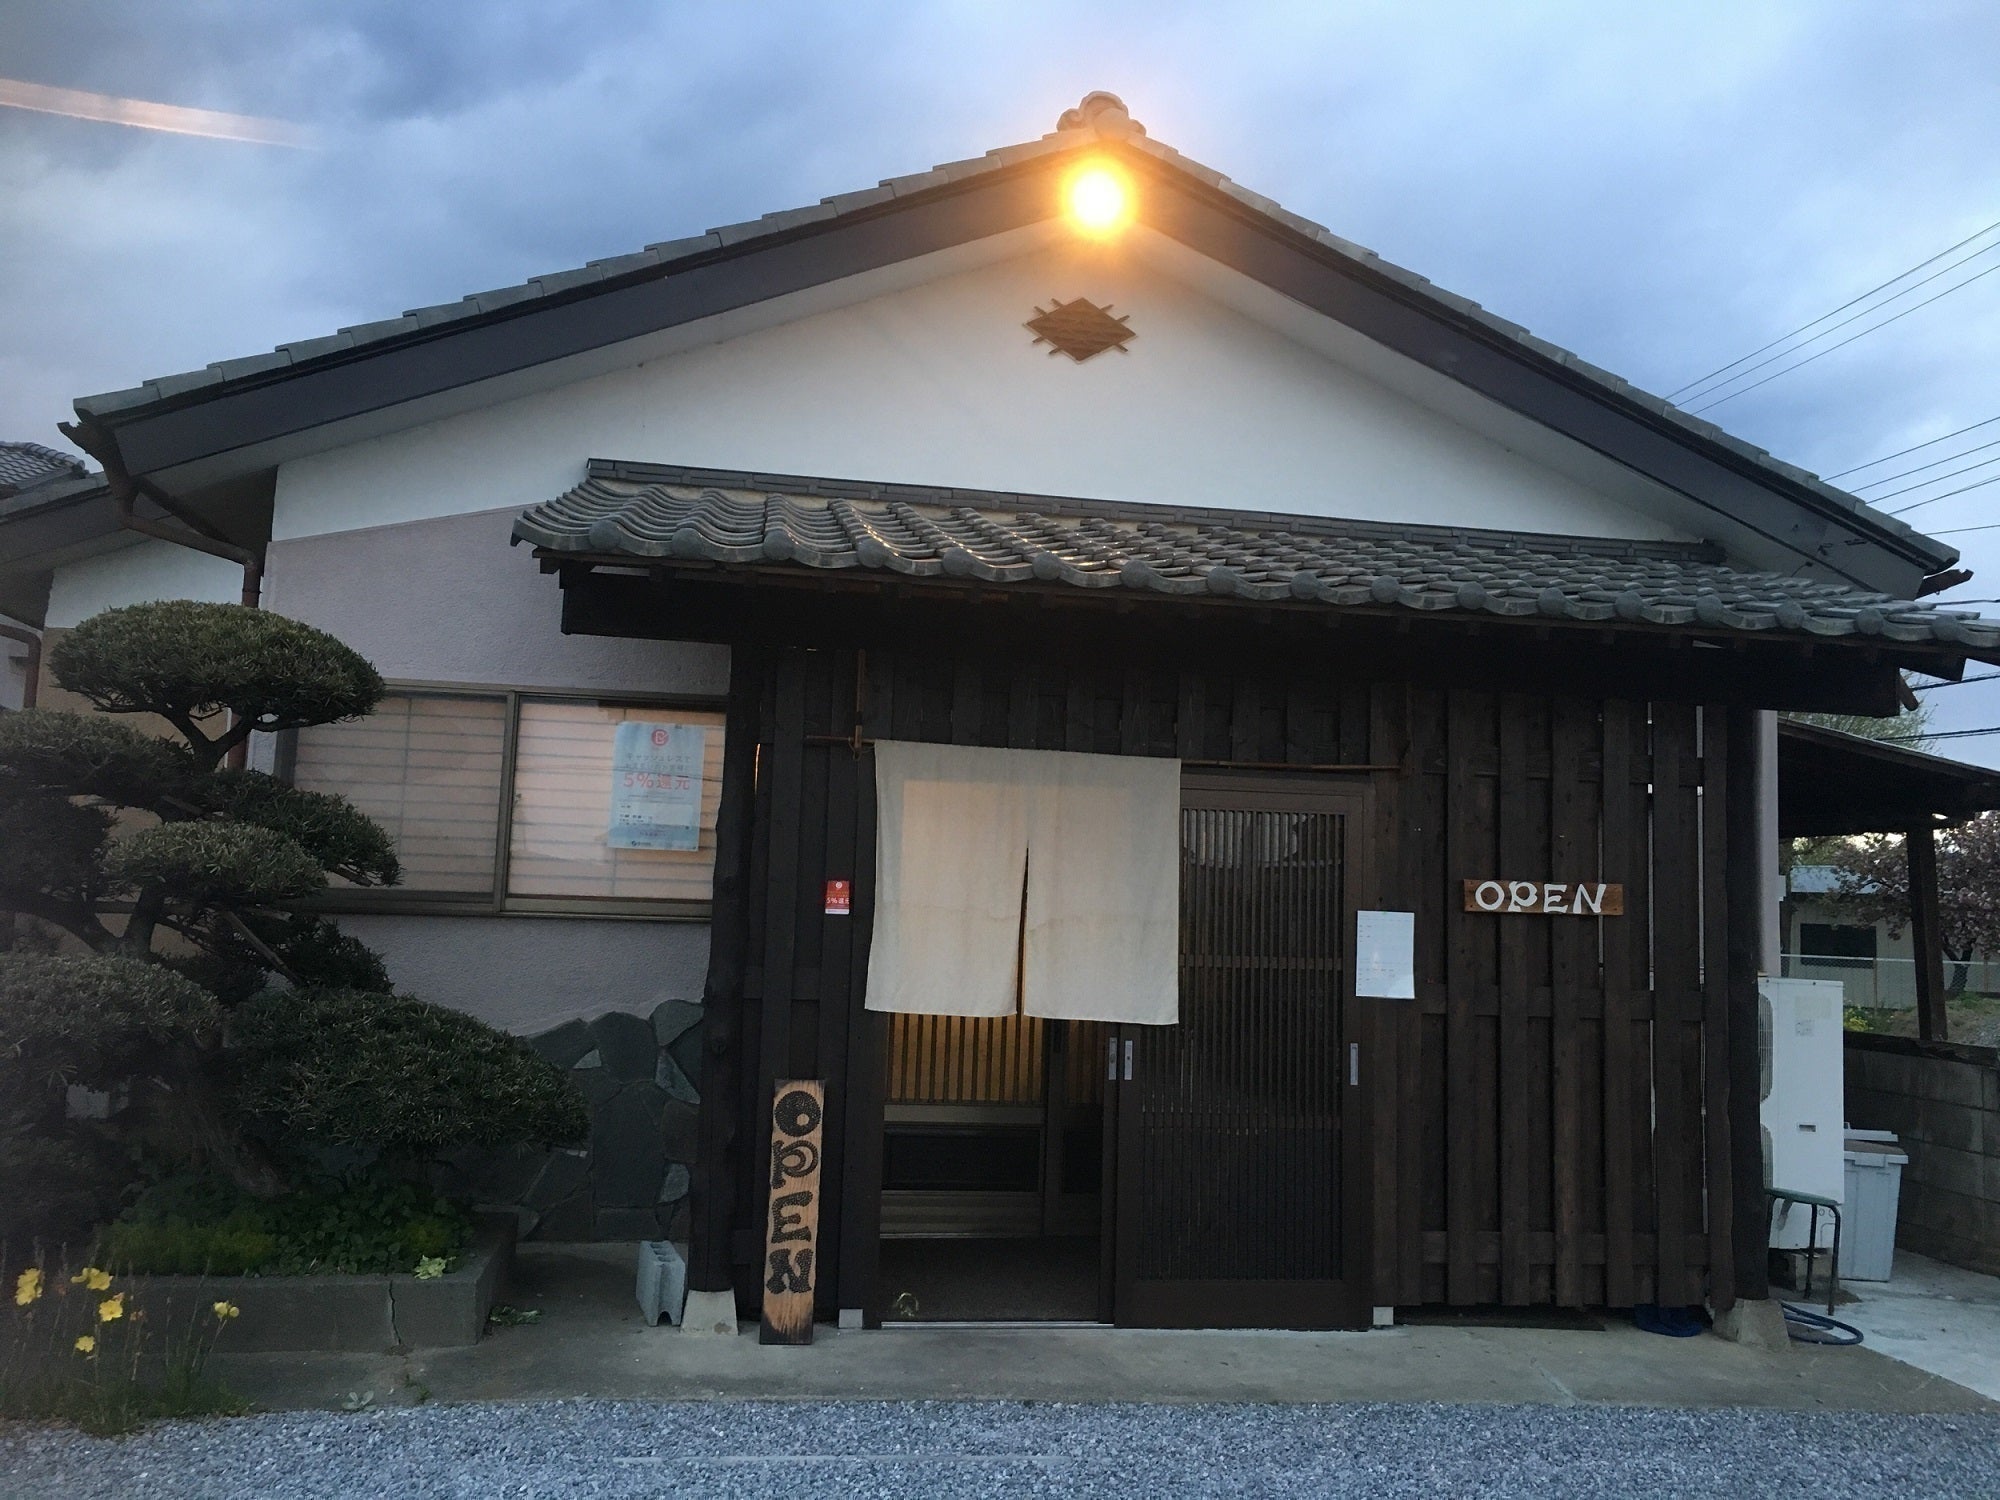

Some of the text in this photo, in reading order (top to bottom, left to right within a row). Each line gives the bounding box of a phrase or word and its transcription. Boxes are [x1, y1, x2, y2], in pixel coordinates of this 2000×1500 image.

[623, 772, 690, 791] 5%還元
[1475, 881, 1607, 914] OPEN
[766, 1090, 822, 1295] OPEN
